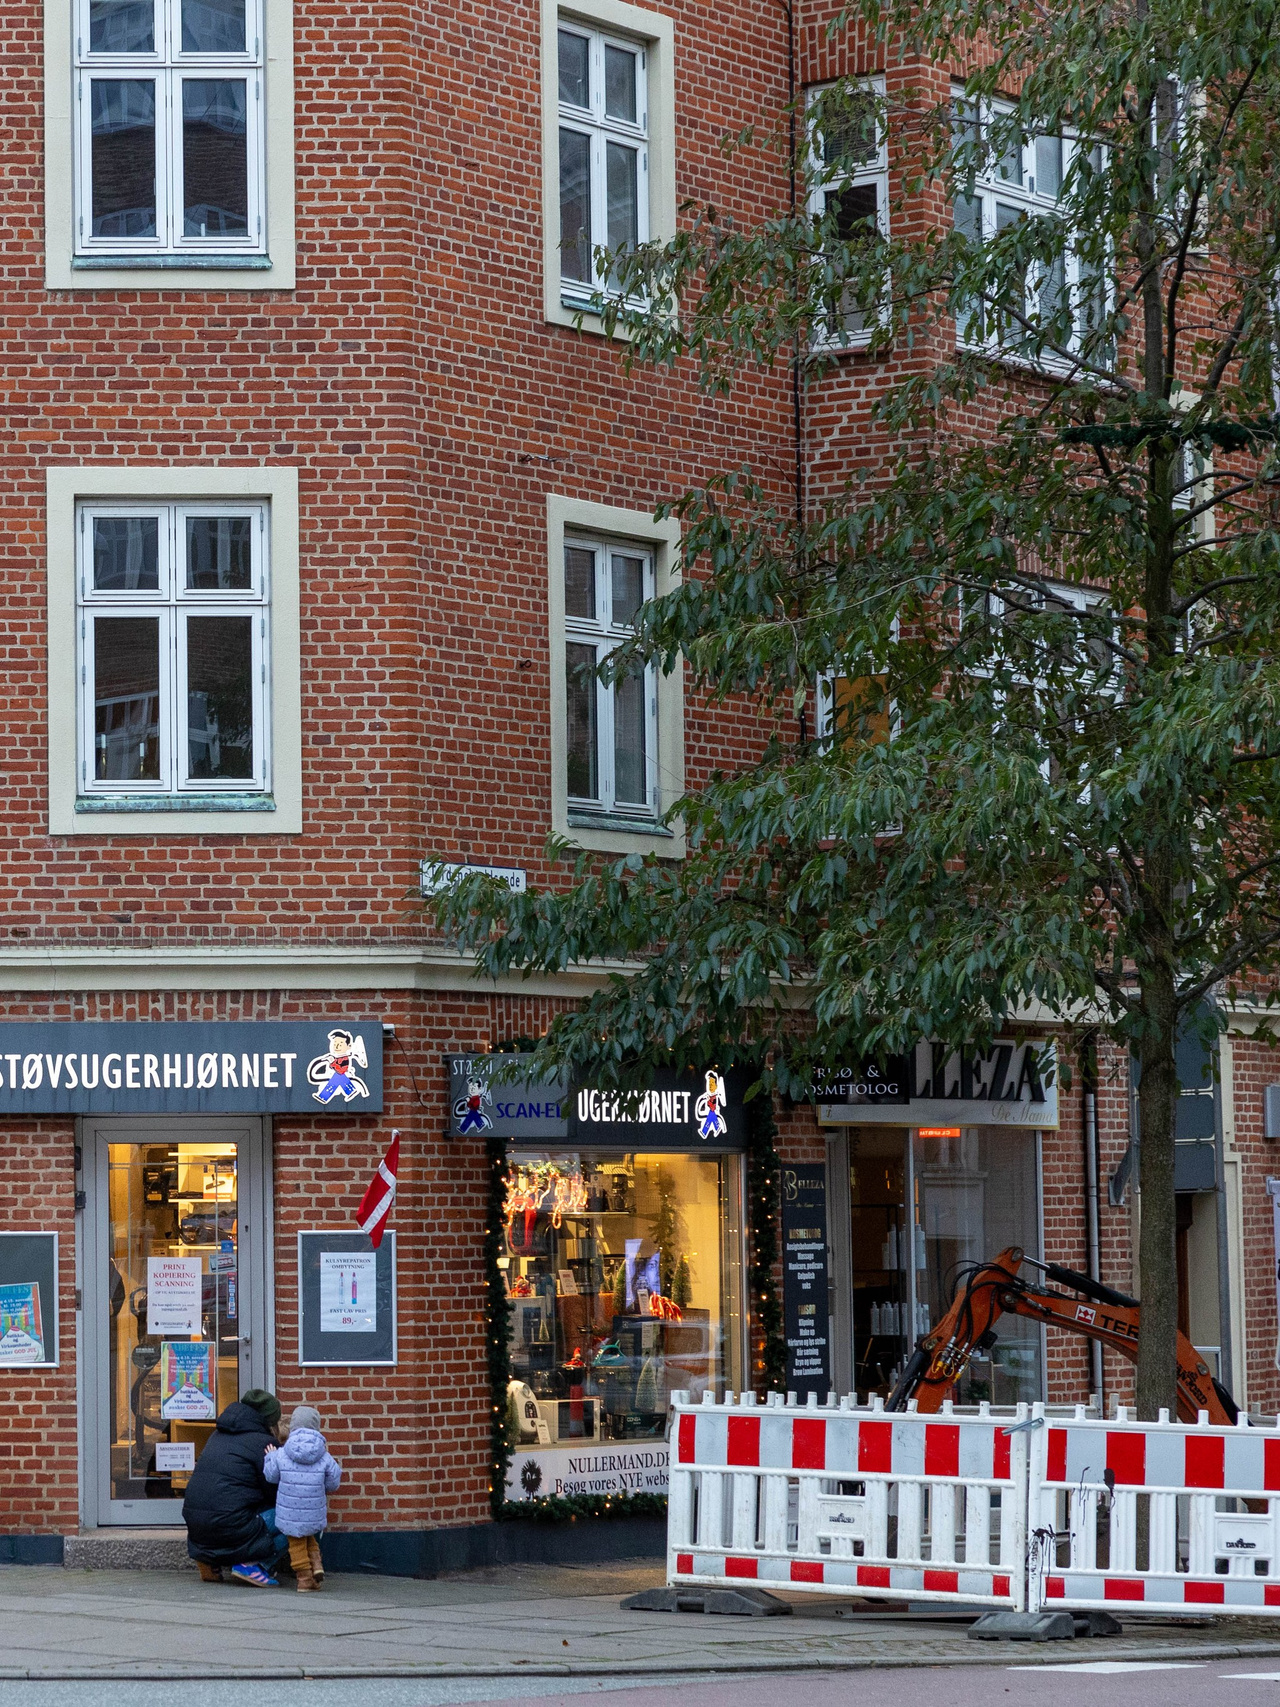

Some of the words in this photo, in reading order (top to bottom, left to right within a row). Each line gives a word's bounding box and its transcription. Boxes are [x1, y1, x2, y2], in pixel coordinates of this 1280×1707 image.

[867, 1065, 880, 1078] &
[802, 1083, 899, 1096] OSMETOLOG
[992, 1102, 1011, 1122] De
[1012, 1102, 1054, 1123] Mama
[555, 1478, 586, 1494] Besøg
[589, 1478, 616, 1491] vores
[619, 1472, 643, 1488] NYE
